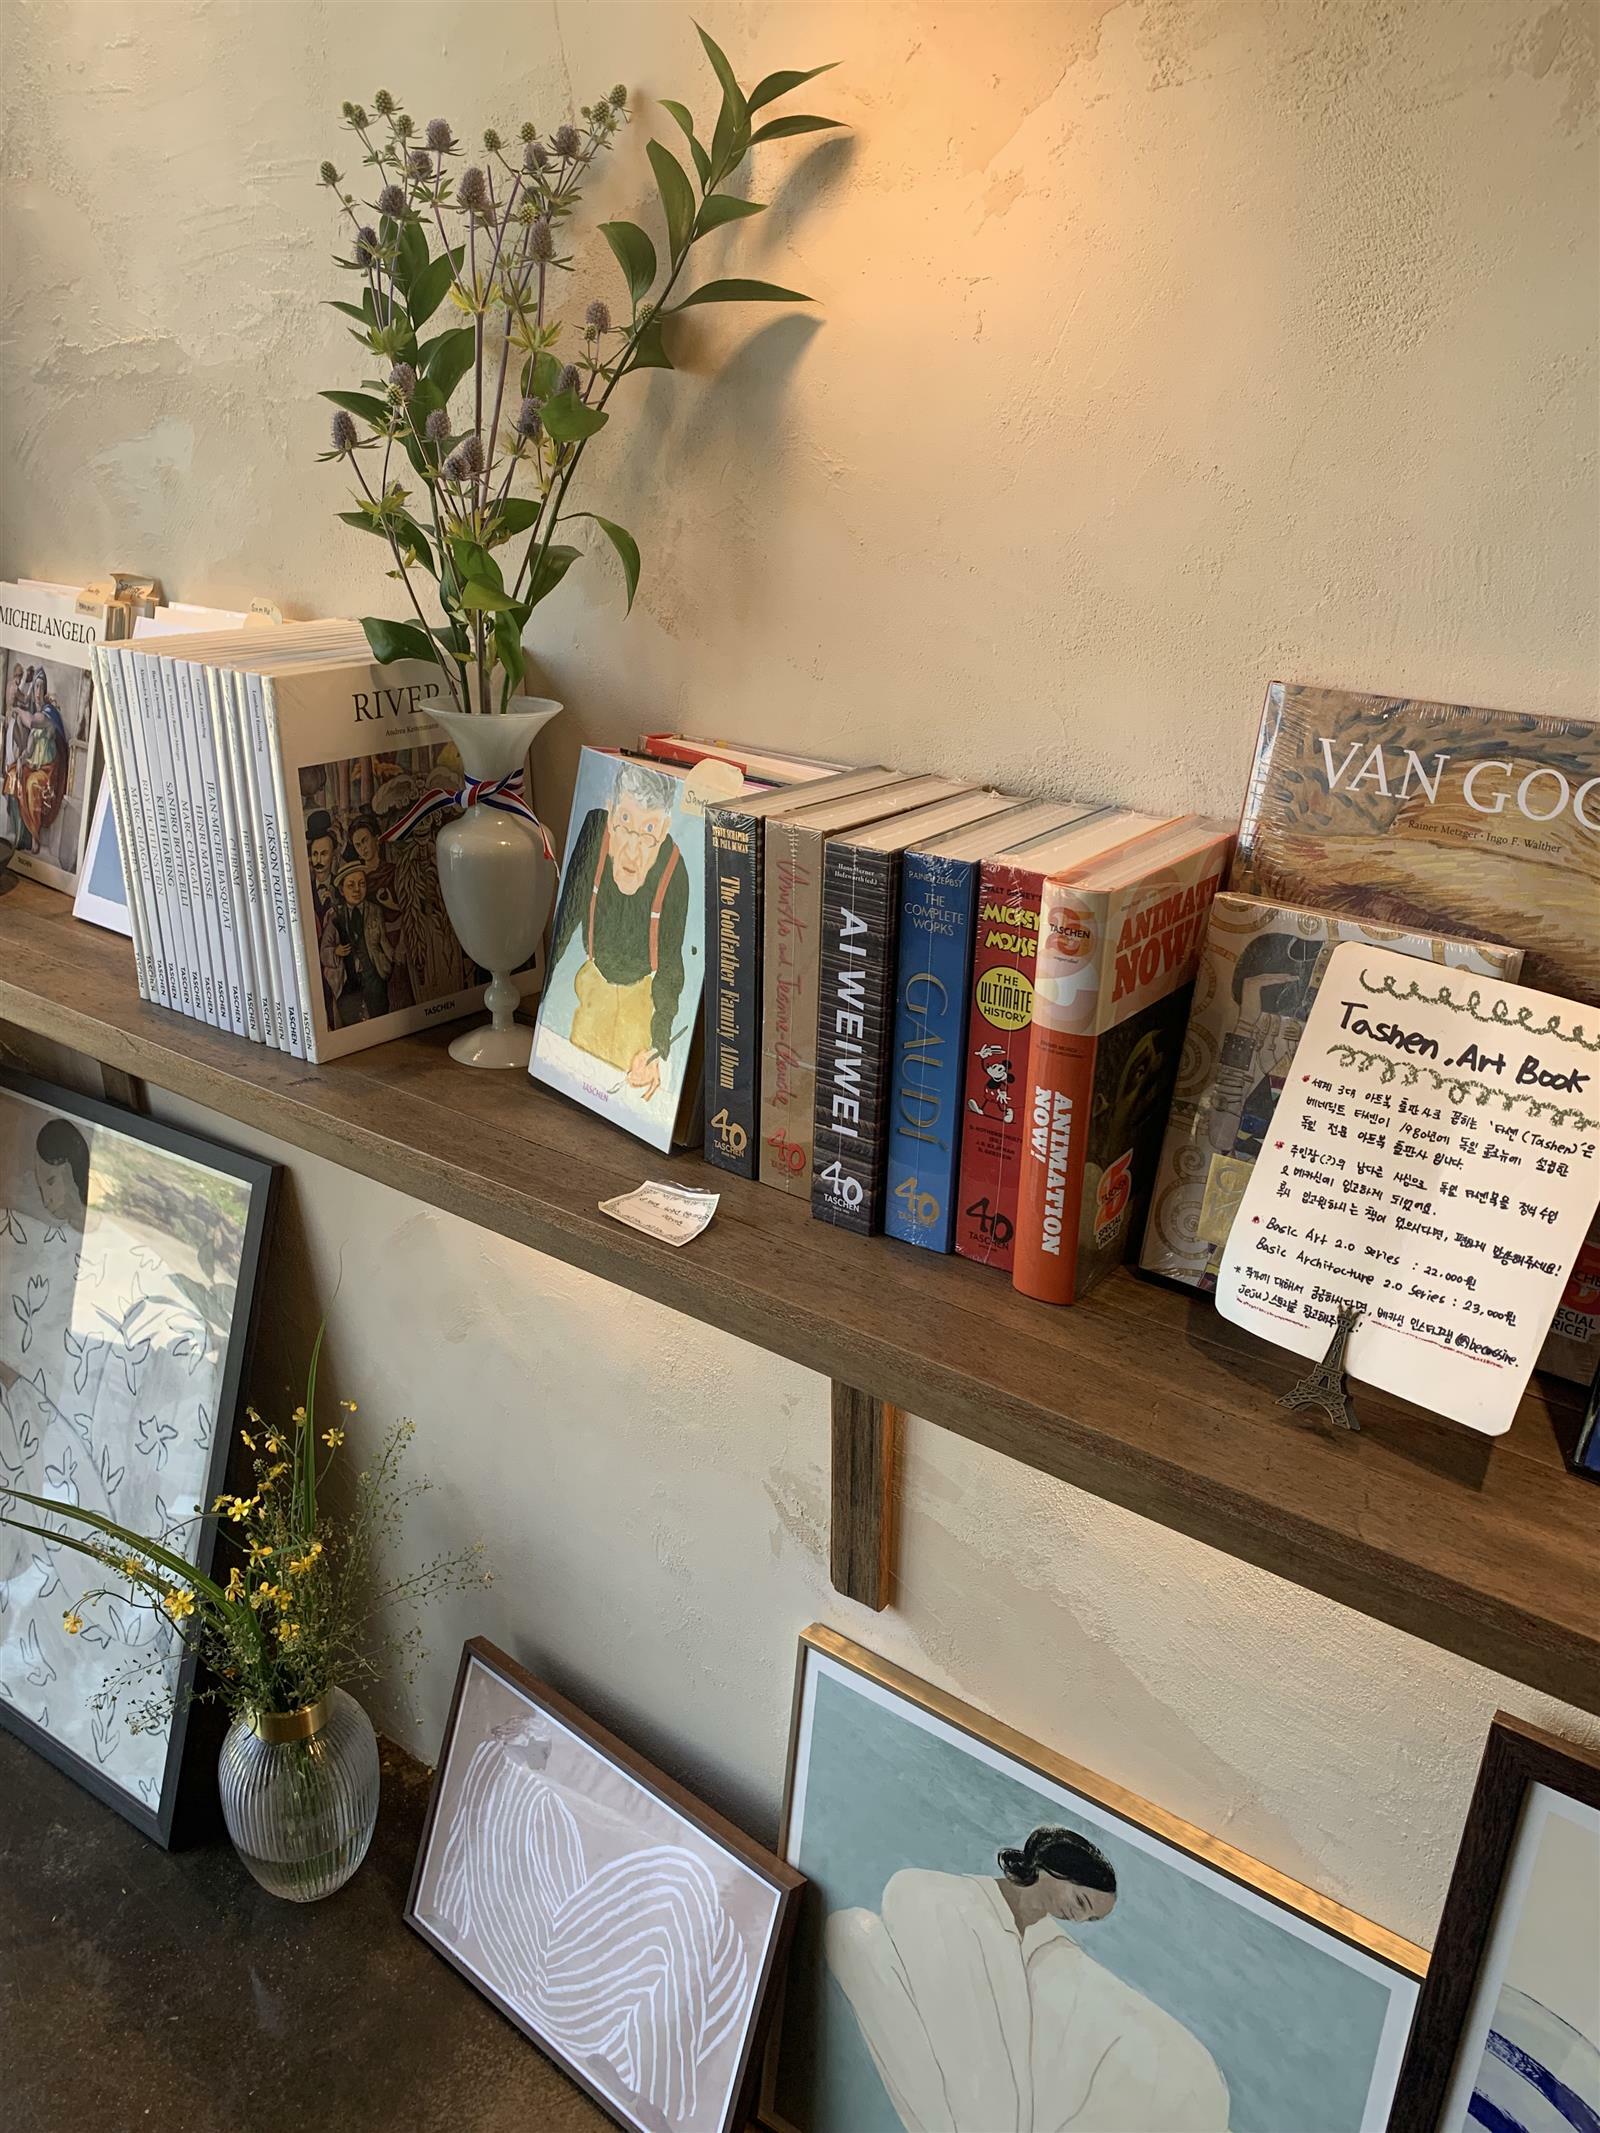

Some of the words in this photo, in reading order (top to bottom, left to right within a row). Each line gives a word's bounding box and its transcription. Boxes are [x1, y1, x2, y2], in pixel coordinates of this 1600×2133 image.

[0, 606, 96, 644] MICHELANGELO
[1318, 738, 1450, 804] VAN
[156, 795, 168, 834] KEITH
[181, 800, 193, 839] MARC
[195, 804, 207, 846] HENRI
[166, 781, 179, 834] SANDRO
[173, 836, 189, 907] BOTTICELLI
[264, 813, 281, 872] JACKSON
[1408, 819, 1438, 833] Rainer
[1440, 824, 1478, 843] Metzger
[1486, 832, 1508, 846] Ingo
[1511, 836, 1521, 847] F.
[1523, 838, 1562, 853] Walther
[161, 836, 175, 887] HARING
[186, 840, 200, 899] CHAGALL
[200, 848, 213, 900] MATISSE
[206, 781, 224, 867] JEAN-MICHEL
[218, 869, 232, 932] BASQUIAT
[272, 875, 287, 934] POLLOCK
[720, 875, 740, 905] The
[924, 893, 945, 907] THE
[839, 907, 868, 957] AI
[904, 903, 964, 925] COMPLETE
[913, 918, 954, 936] WORKS
[982, 903, 1040, 931] MICKEY
[1050, 923, 1090, 939] TASCHEN
[720, 908, 740, 987] Godfather
[985, 929, 1038, 958] MOUSE
[157, 960, 166, 996] TASCHEN
[168, 963, 177, 999] TASCHEN
[180, 967, 190, 1004] TASCHEN
[191, 971, 201, 1008] TASCHEN
[204, 977, 214, 1014] TASCHEN
[980, 981, 1033, 1013] ULTIMATE
[996, 973, 1018, 987] THE
[217, 980, 226, 1018] TASCHEN
[232, 985, 241, 1024] TASCHEN
[246, 992, 256, 1031] TASCHEN
[262, 997, 272, 1036] TASCHEN
[424, 1000, 455, 1017] TASCHEN
[716, 988, 740, 1040] Family
[984, 1006, 1026, 1023] HISTORY
[288, 1006, 298, 1045] TASCHEN
[303, 1012, 313, 1051] TASCHEN
[720, 1043, 740, 1090] Album
[831, 971, 866, 1138] WEIWEI
[1515, 1055, 1591, 1093] Book
[1338, 1085, 1356, 1098] 3대
[1365, 1092, 1392, 1109] 아트북
[711, 1108, 748, 1153] 40
[1030, 1085, 1052, 1164] NOW!
[1301, 1115, 1317, 1132] 독일
[1328, 1122, 1348, 1138] 전문
[1357, 1131, 1386, 1149] 아트북
[768, 1128, 806, 1171] 40
[1398, 1122, 1450, 1145] 1980년에
[1459, 1136, 1479, 1155] 독일
[1536, 1157, 1569, 1177] 설립한
[820, 1161, 864, 1205] 40
[1041, 1091, 1073, 1256] ANIMATION
[1276, 1180, 1291, 1198] 혹시
[1343, 1179, 1384, 1201] 입고하게
[1357, 1161, 1384, 1178] 남다른
[1393, 1171, 1428, 1190] 사심으로
[1439, 1181, 1458, 1198] 독일
[823, 1193, 860, 1213] TASCHEN
[895, 1176, 940, 1225] 40
[966, 1197, 1014, 1244] 40
[1265, 1217, 1298, 1238] Basic
[1305, 1228, 1328, 1246] Art
[1334, 1239, 1356, 1252] 2.0
[1255, 1236, 1287, 1258] Basic
[1383, 1279, 1403, 1291] 2.0
[1274, 1276, 1304, 1295] 대해서
